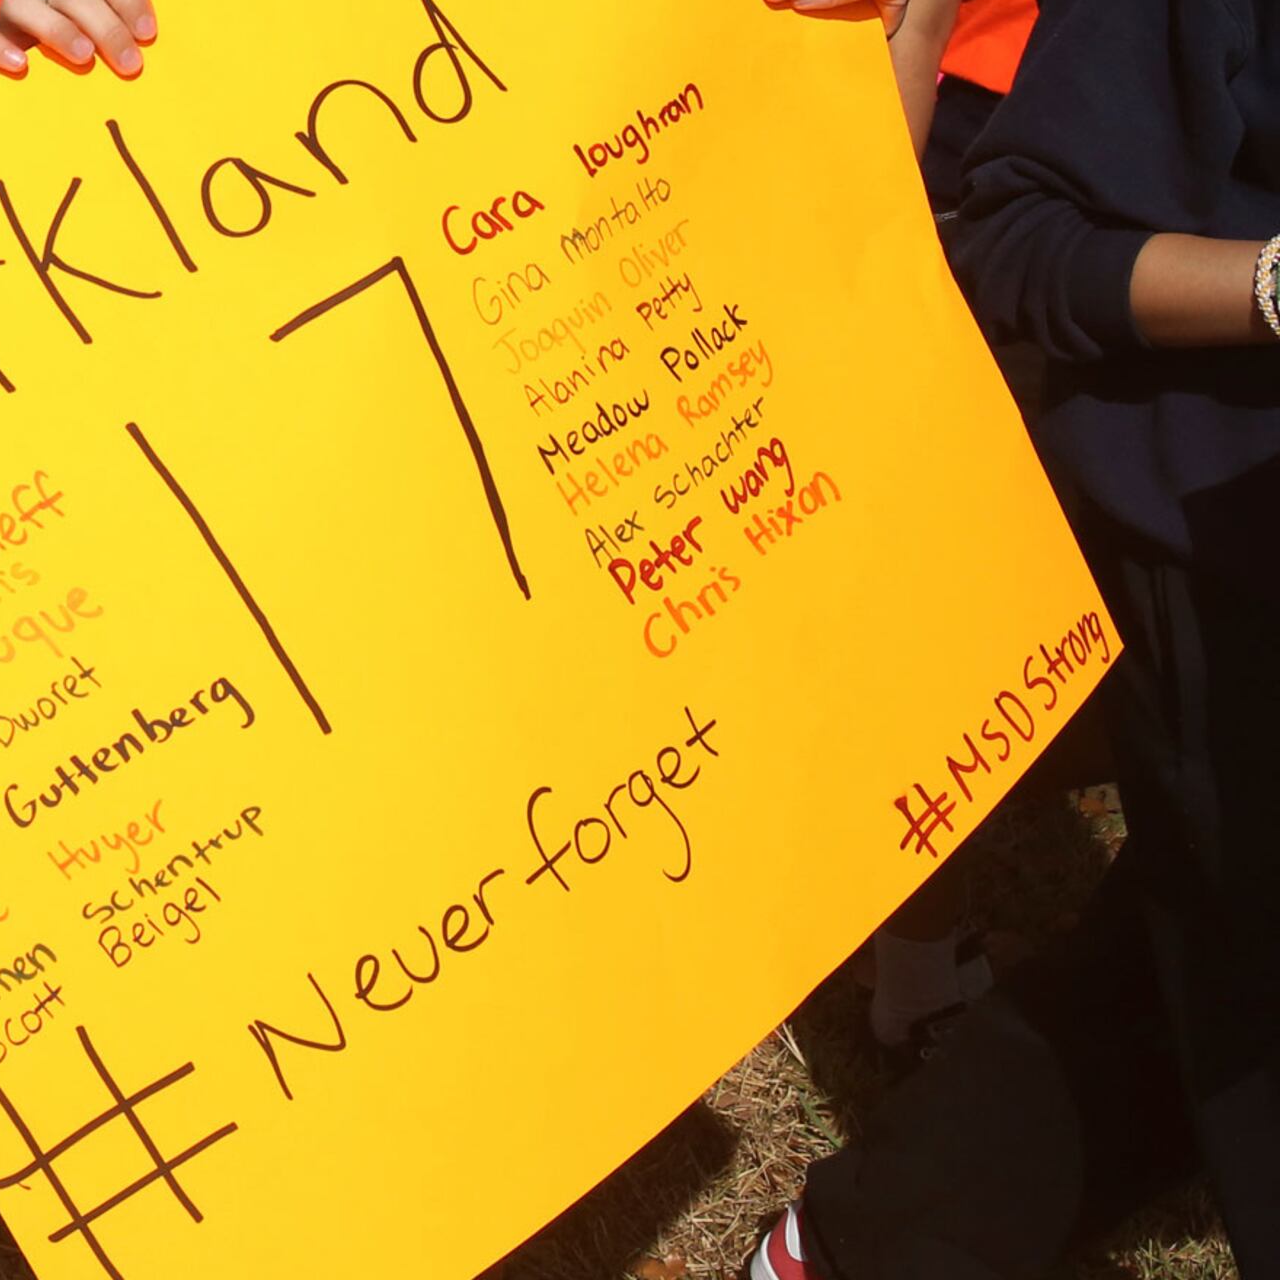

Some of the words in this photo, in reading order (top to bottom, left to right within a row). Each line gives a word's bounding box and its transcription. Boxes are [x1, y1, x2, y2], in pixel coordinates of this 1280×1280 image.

[441, 190, 545, 256] Cara
[472, 263, 551, 326] Gina
[492, 290, 612, 374] Joaquin
[618, 218, 689, 288] Oliver
[635, 272, 703, 331] Petty
[537, 388, 650, 475] Meadow
[660, 304, 748, 383] Pollack
[556, 432, 669, 516] Helena
[676, 340, 773, 428] Ramsey
[585, 510, 645, 569] Alex
[608, 516, 703, 605] Peter
[643, 566, 741, 658] Chris
[744, 470, 842, 556] Hixon
[3, 676, 255, 828] Guttenberg
[98, 876, 222, 968] Beigel
